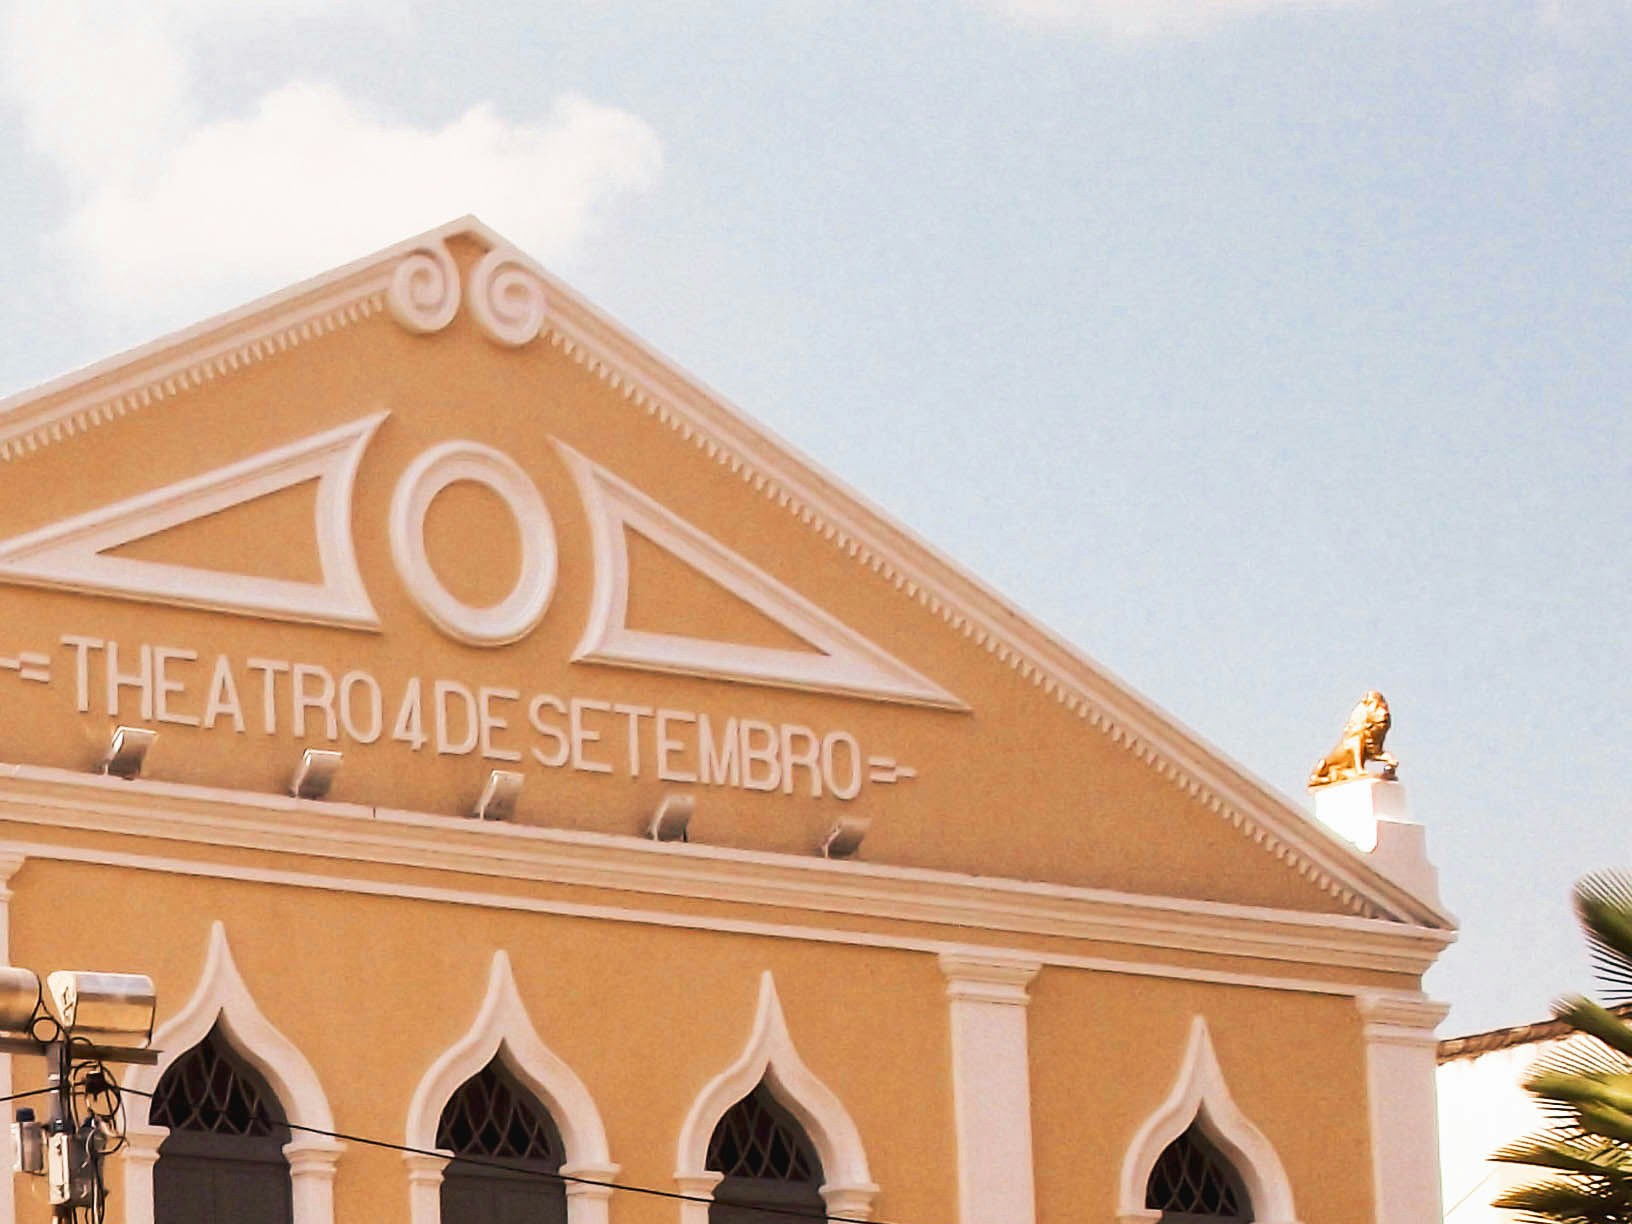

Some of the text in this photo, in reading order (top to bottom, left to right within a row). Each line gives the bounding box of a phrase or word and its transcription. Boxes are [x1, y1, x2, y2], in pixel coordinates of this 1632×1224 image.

[60, 635, 862, 800] THEATRO 4 DE SETEMBRO
